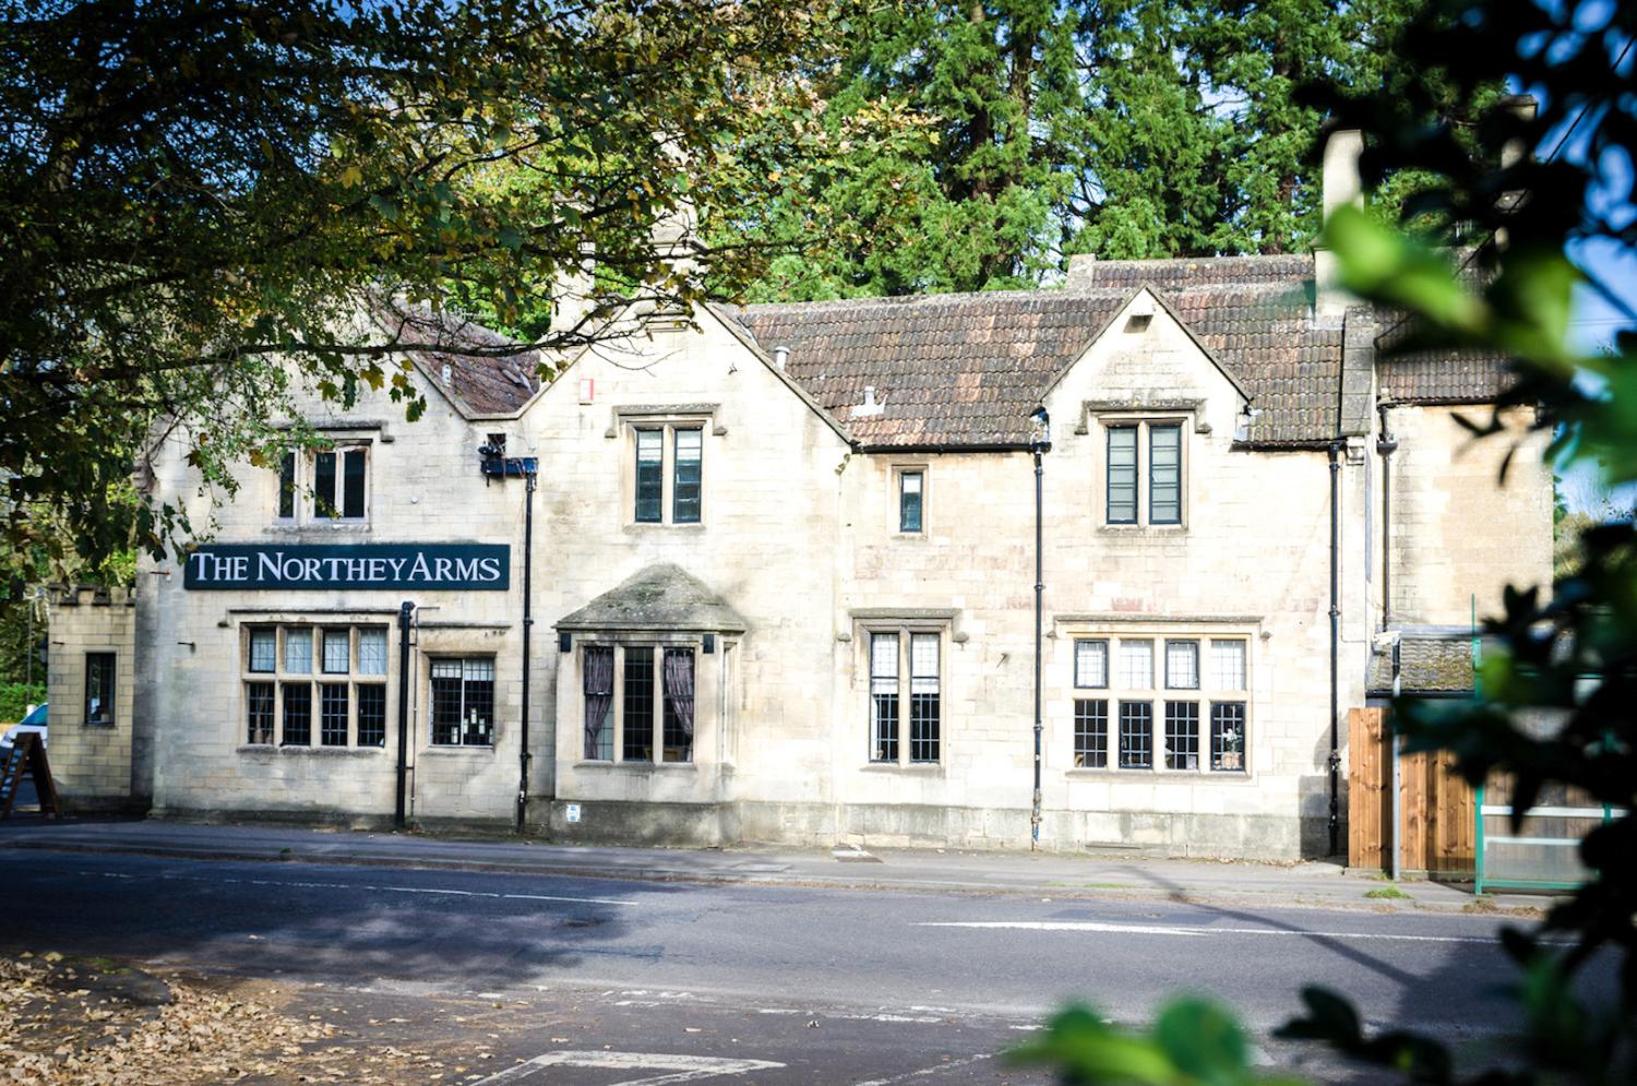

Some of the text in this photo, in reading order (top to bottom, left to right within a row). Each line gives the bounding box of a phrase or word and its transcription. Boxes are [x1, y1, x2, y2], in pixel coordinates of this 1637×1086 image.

[190, 552, 501, 582] THE NORTHEY ARMS
